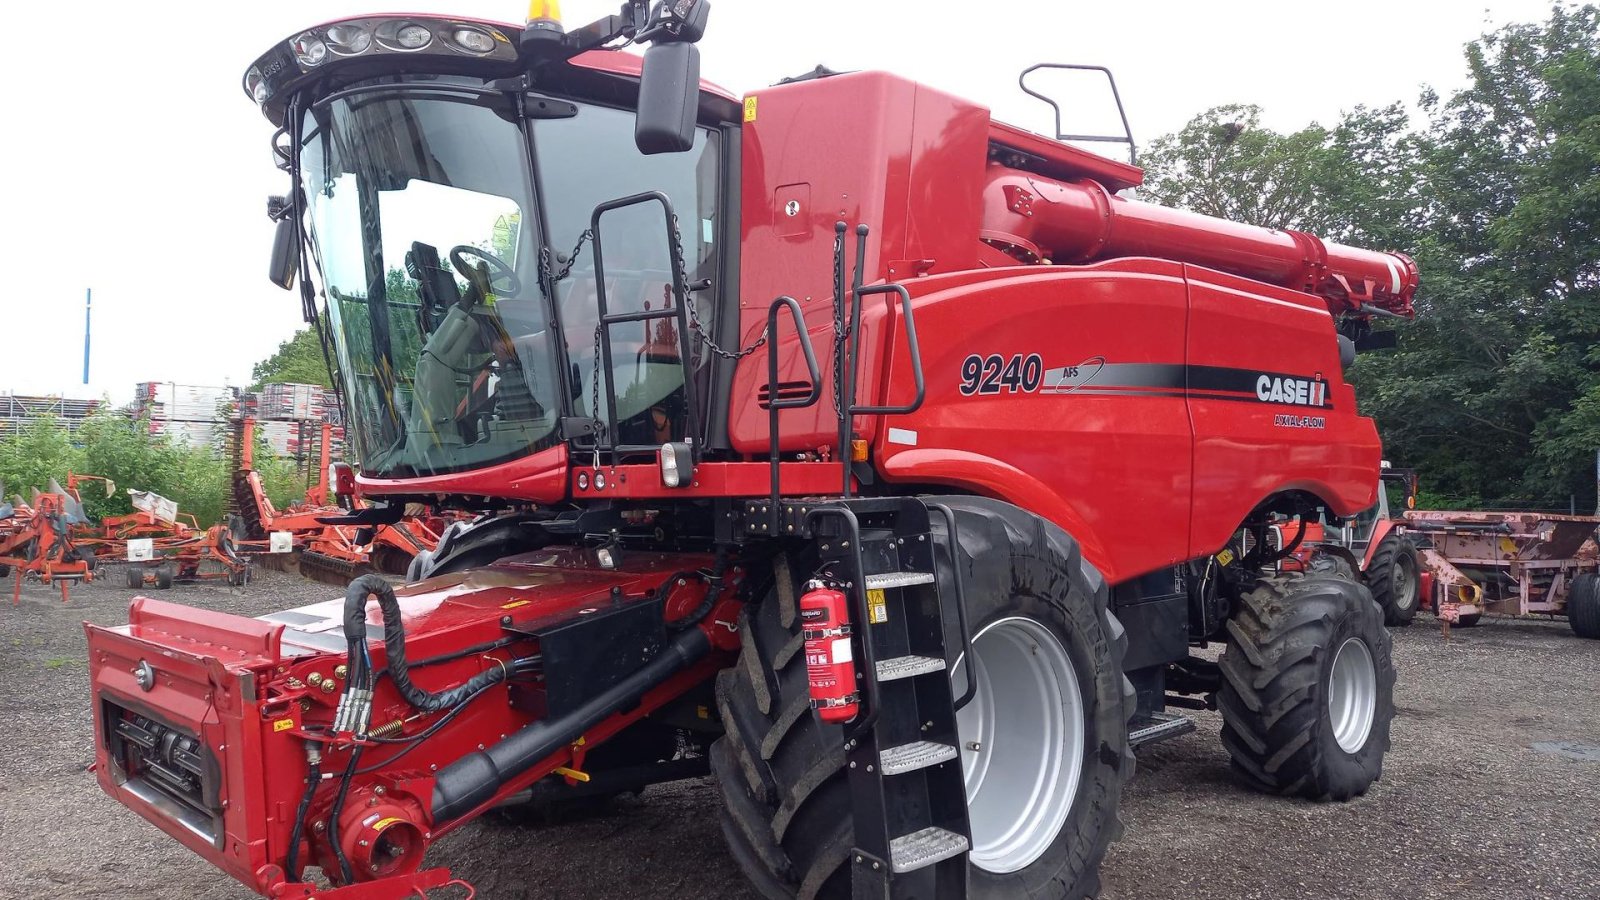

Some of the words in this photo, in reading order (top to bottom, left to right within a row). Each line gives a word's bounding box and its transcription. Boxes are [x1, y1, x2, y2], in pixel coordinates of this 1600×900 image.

[959, 353, 1042, 396] 9240
[1063, 367, 1079, 379] AFS
[1274, 414, 1326, 429] AXIAL-FLOW
